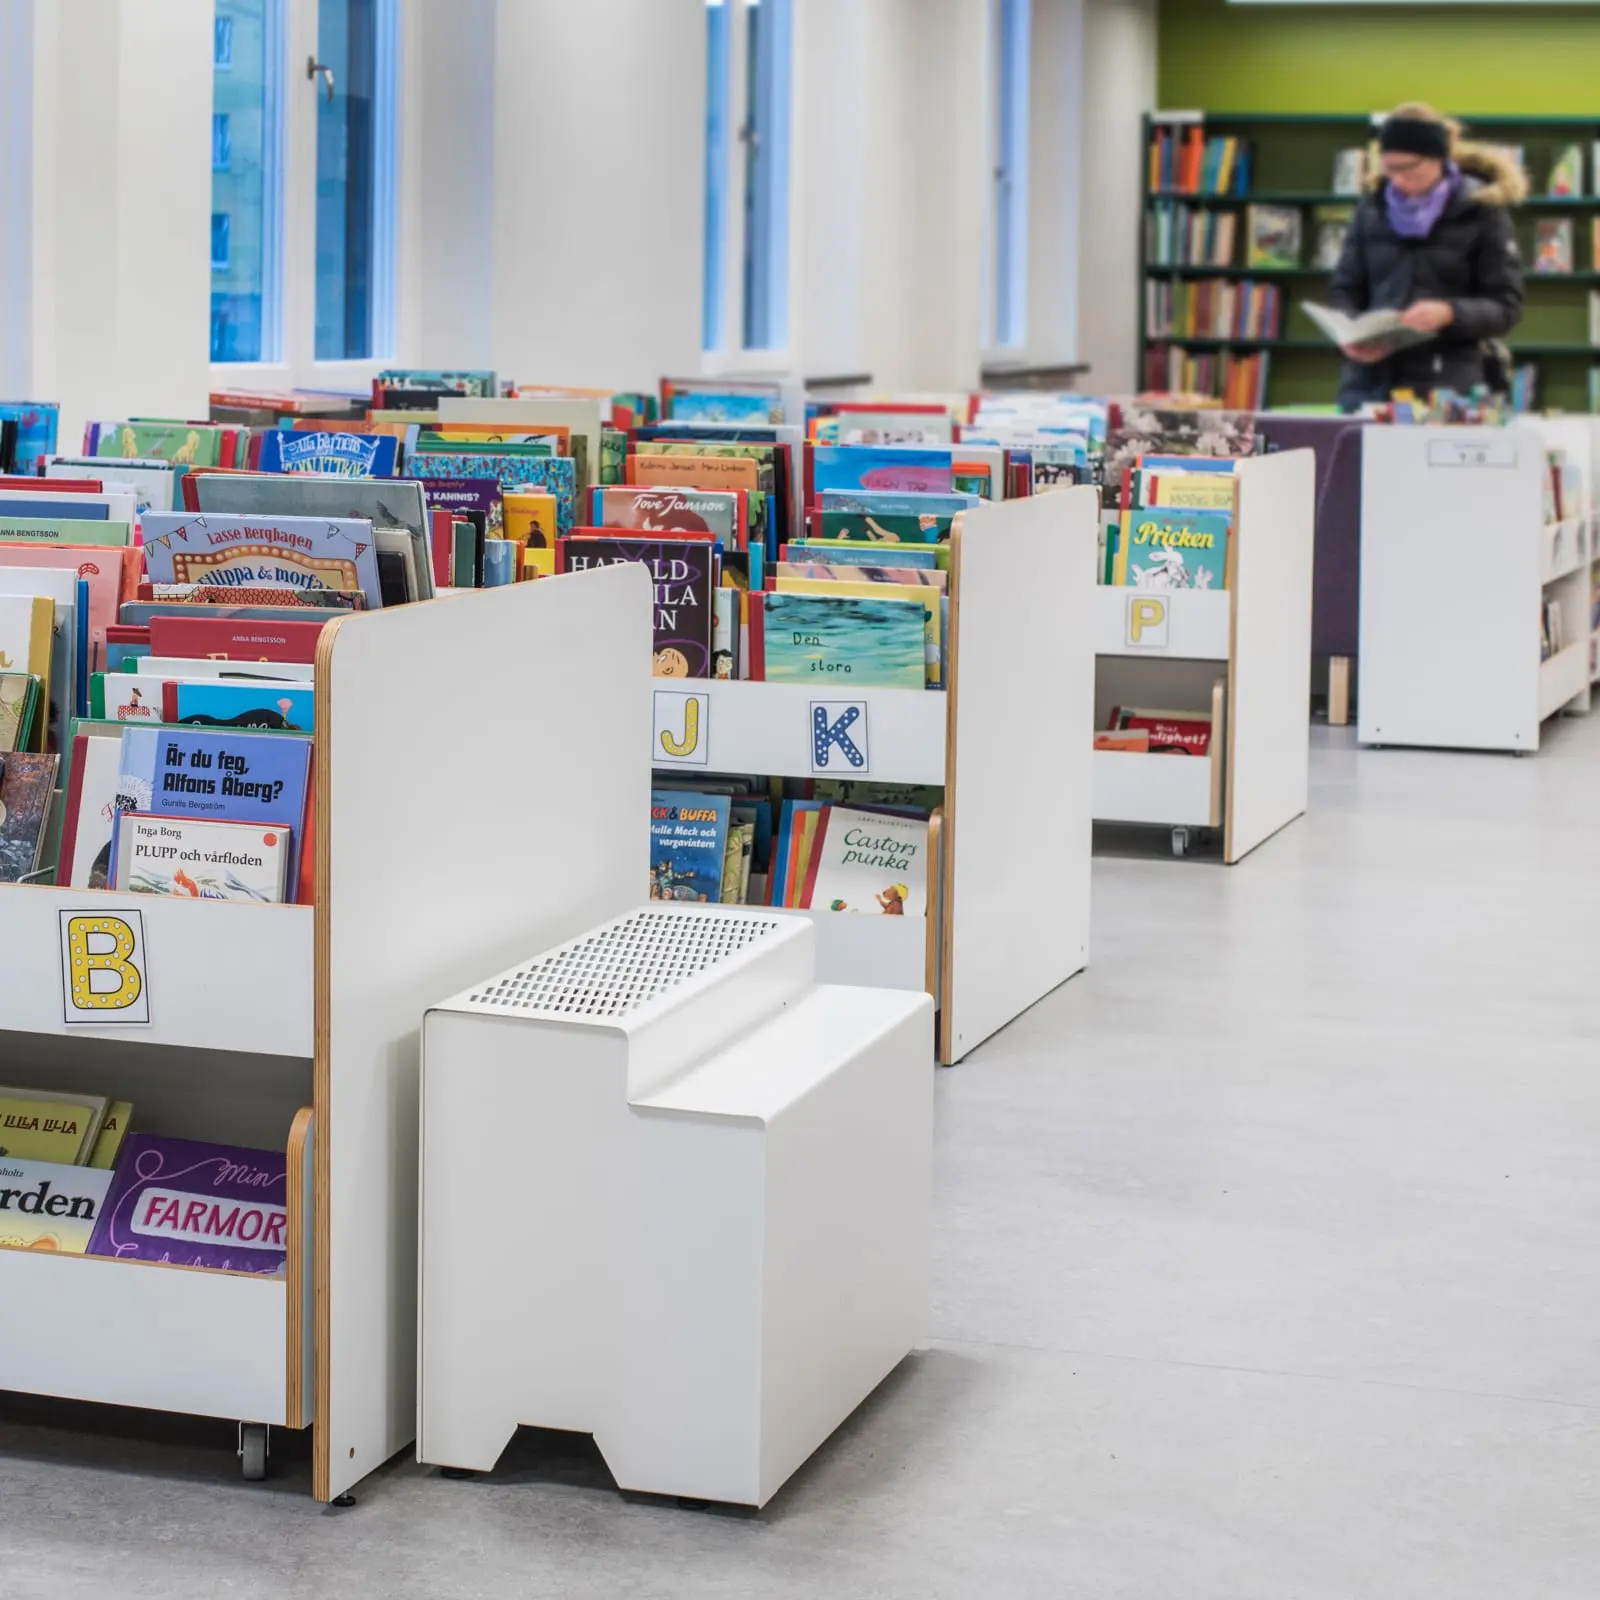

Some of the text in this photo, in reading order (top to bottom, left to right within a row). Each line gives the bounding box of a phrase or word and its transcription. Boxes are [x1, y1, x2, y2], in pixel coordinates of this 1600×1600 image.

[632, 493, 726, 517] Tove Jansson
[0, 529, 59, 538] NNA BENGTSSON
[206, 526, 313, 551] Lasse Berghagen
[1133, 522, 1215, 549] Pricken
[257, 566, 272, 580] &
[1130, 599, 1165, 643] P
[232, 635, 286, 645] ANNA BENGTSSON
[793, 632, 821, 646] Den
[810, 659, 852, 673] stora
[660, 697, 699, 757] J
[814, 706, 864, 767] K
[165, 743, 249, 775] Är du feg,
[163, 771, 284, 803] Alfons Åberg?
[161, 798, 226, 812] Gunilla Bergström
[669, 806, 678, 820] &
[679, 808, 718, 822] BUFFA
[137, 825, 182, 840] Inga Borg
[674, 825, 698, 836] Meck
[700, 828, 717, 837] och
[844, 828, 919, 857] Castors
[659, 838, 716, 849] vargavintern
[135, 845, 263, 867] PLUPP och vårfloden
[842, 850, 909, 871] punka
[68, 916, 142, 1010] B
[4, 1114, 77, 1135] LILLA LILLA
[213, 1163, 274, 1187] Min
[0, 1181, 96, 1220] rden
[142, 1196, 287, 1246] FARMOR
